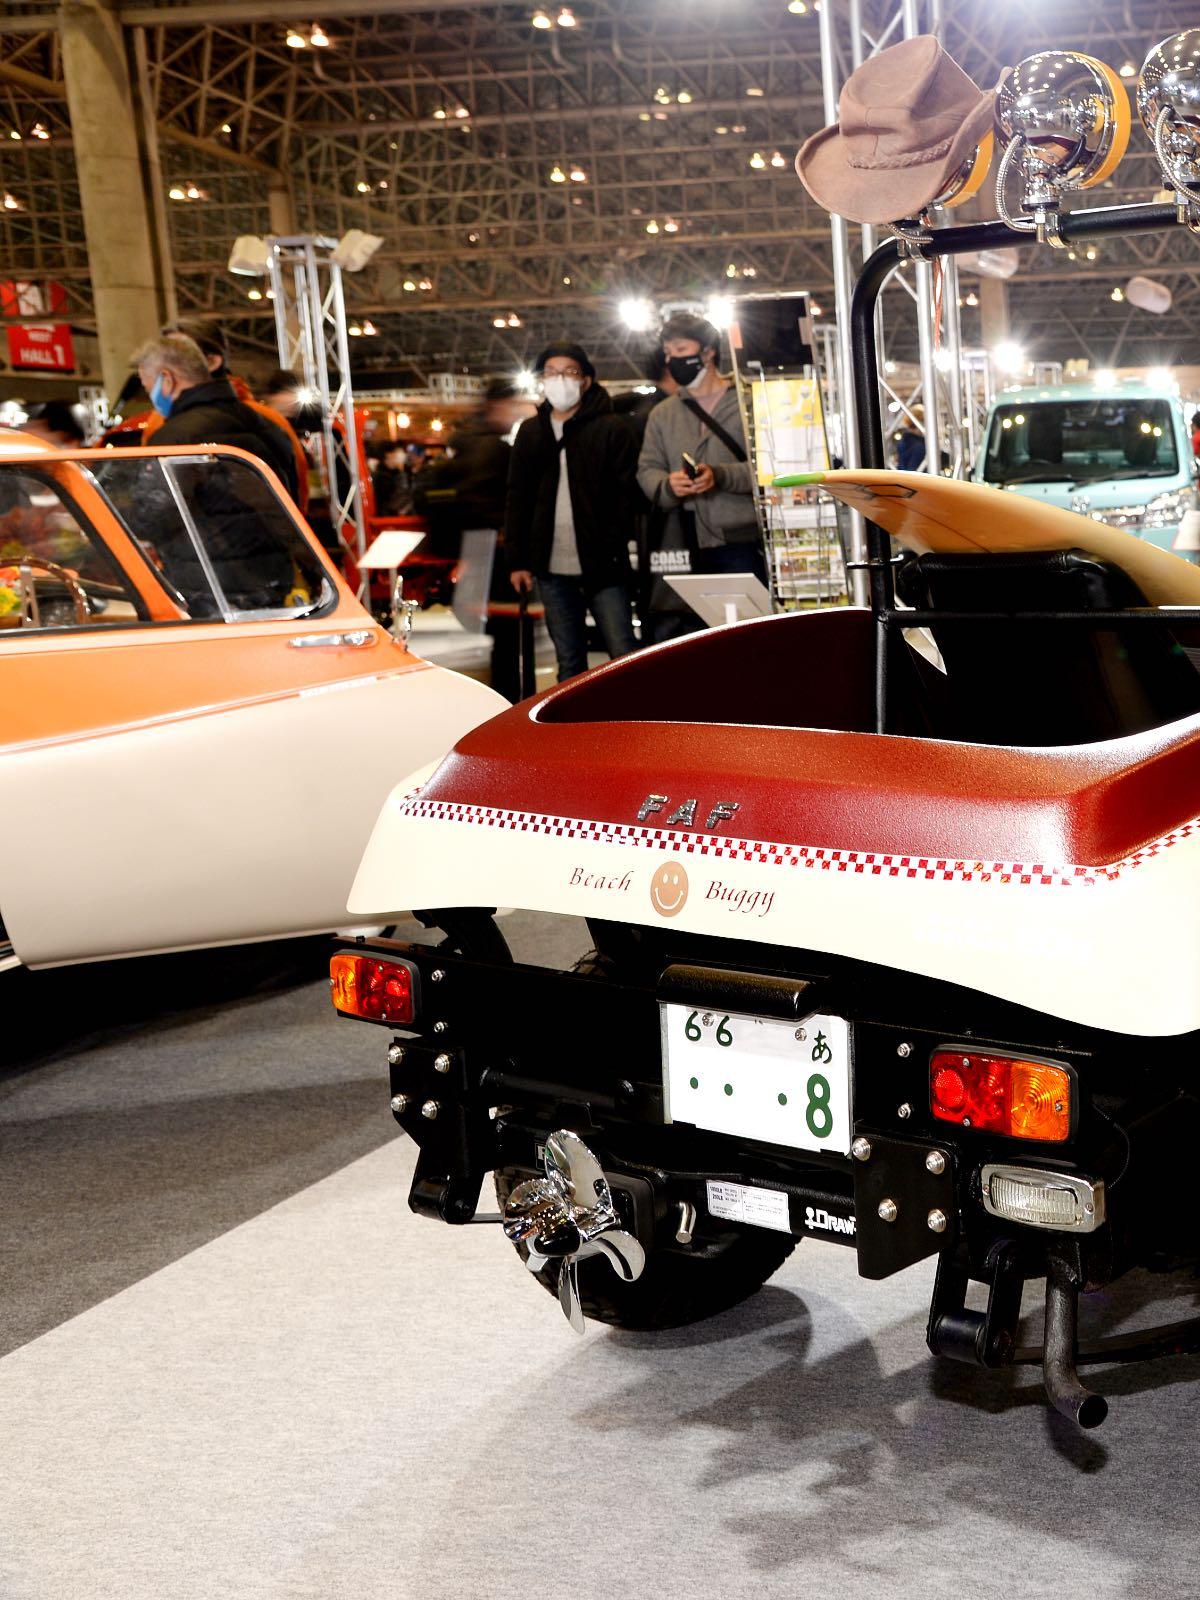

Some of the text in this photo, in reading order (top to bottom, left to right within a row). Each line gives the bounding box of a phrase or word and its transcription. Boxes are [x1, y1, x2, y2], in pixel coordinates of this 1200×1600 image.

[19, 344, 66, 366] HALL 1
[649, 550, 691, 566] COAST
[637, 794, 740, 829] FAF
[569, 867, 777, 918] Beach Buggy
[811, 1030, 832, 1064] あ
[806, 1206, 857, 1236] DRAW
